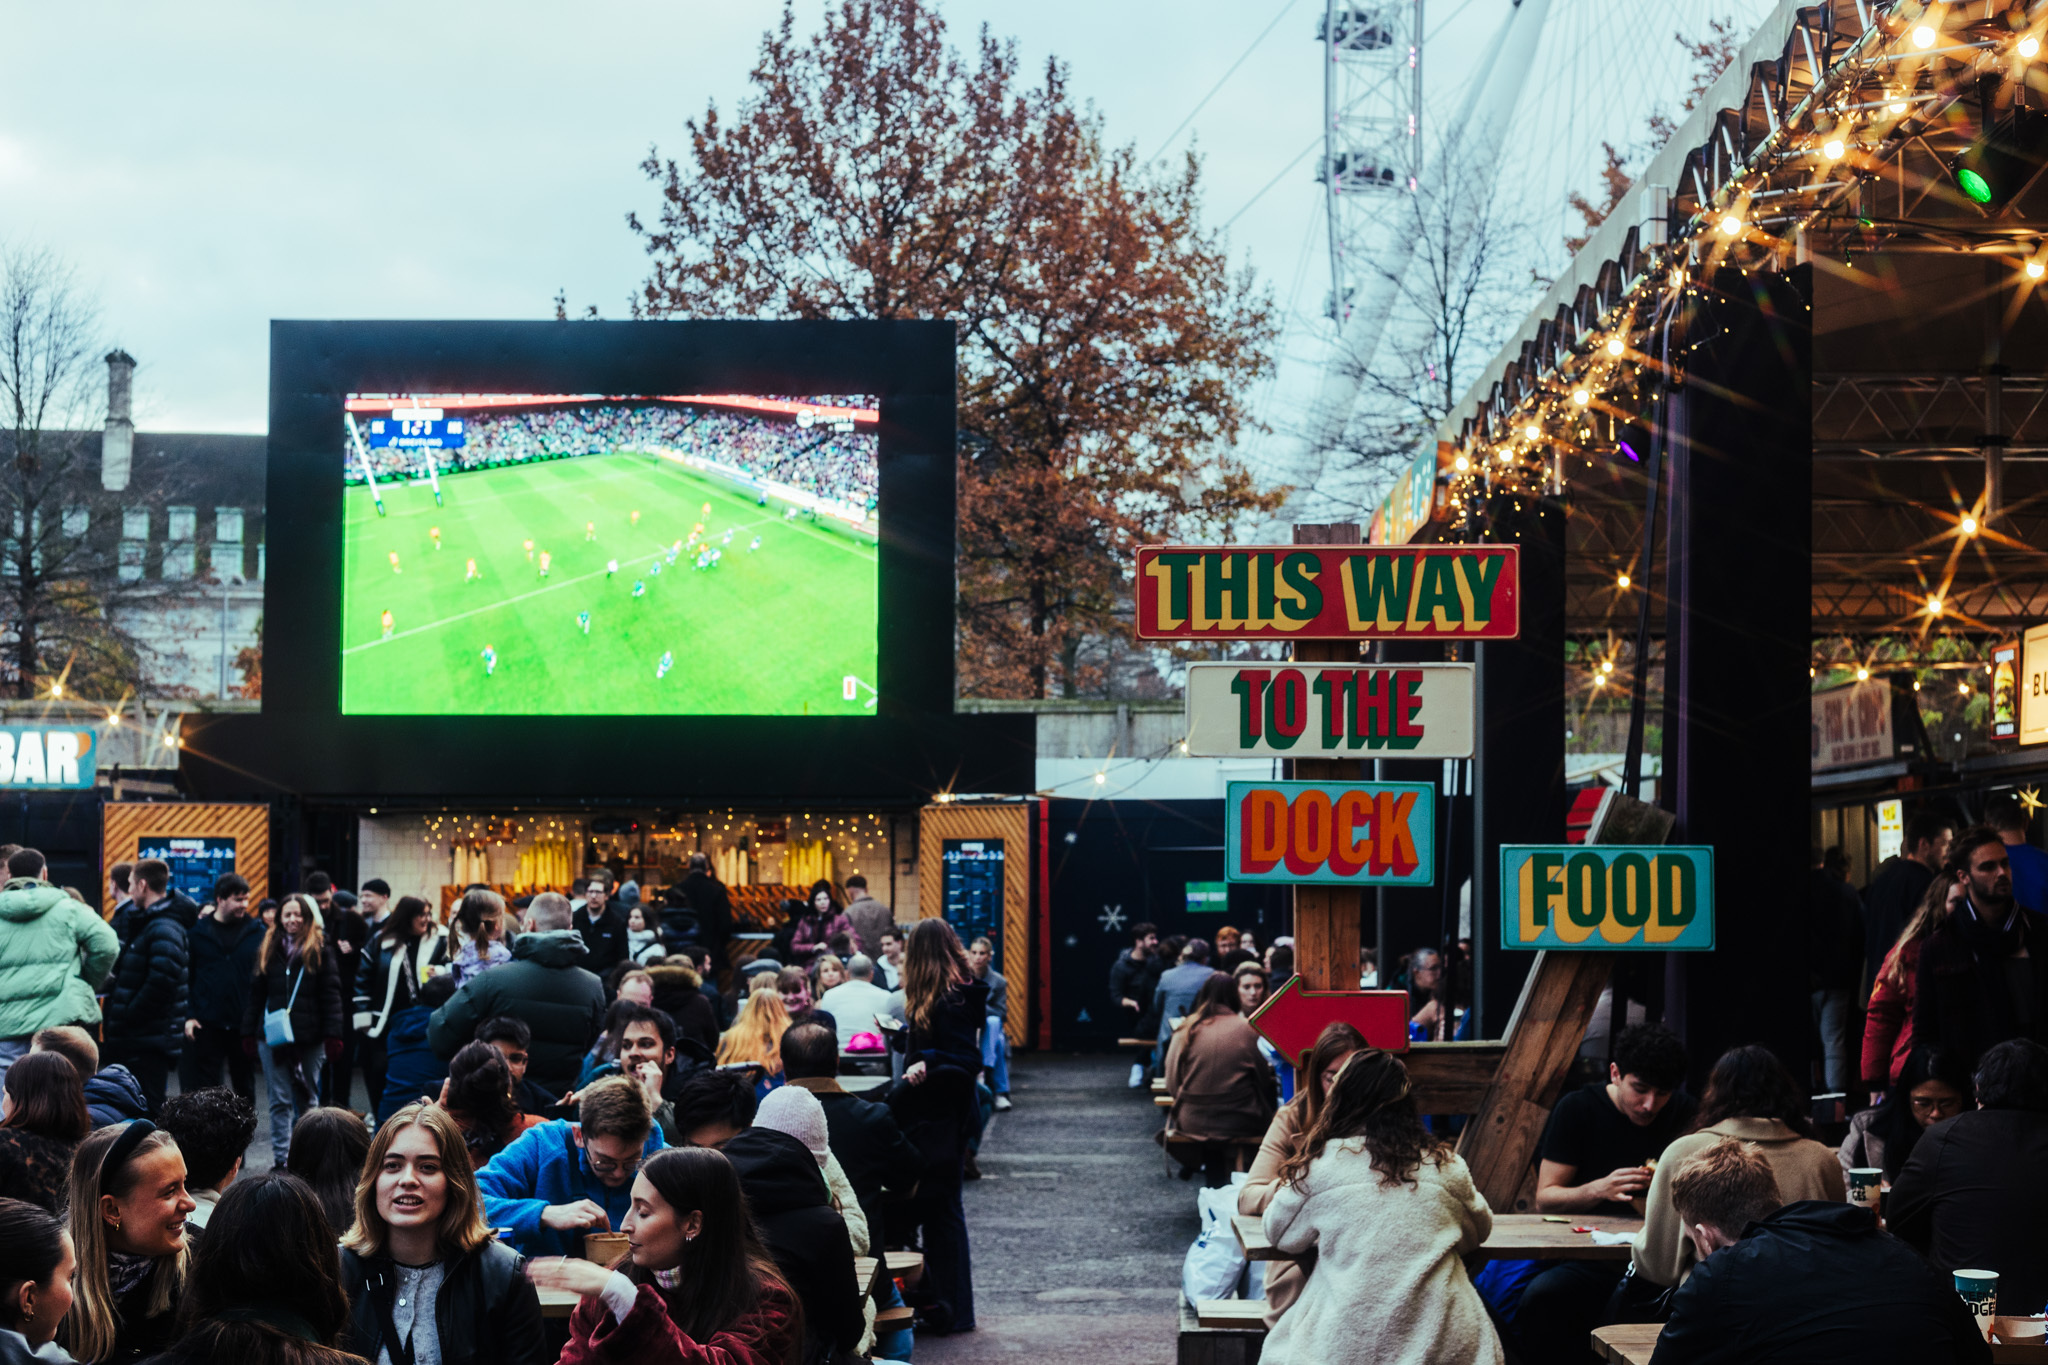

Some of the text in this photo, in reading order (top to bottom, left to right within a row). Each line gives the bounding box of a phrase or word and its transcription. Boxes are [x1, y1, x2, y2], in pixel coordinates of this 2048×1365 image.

[1146, 552, 1506, 632] THIS WAY
[1231, 669, 1425, 750] TO THE
[1240, 789, 1420, 877] DOCK
[1519, 852, 1697, 944] FOOD
